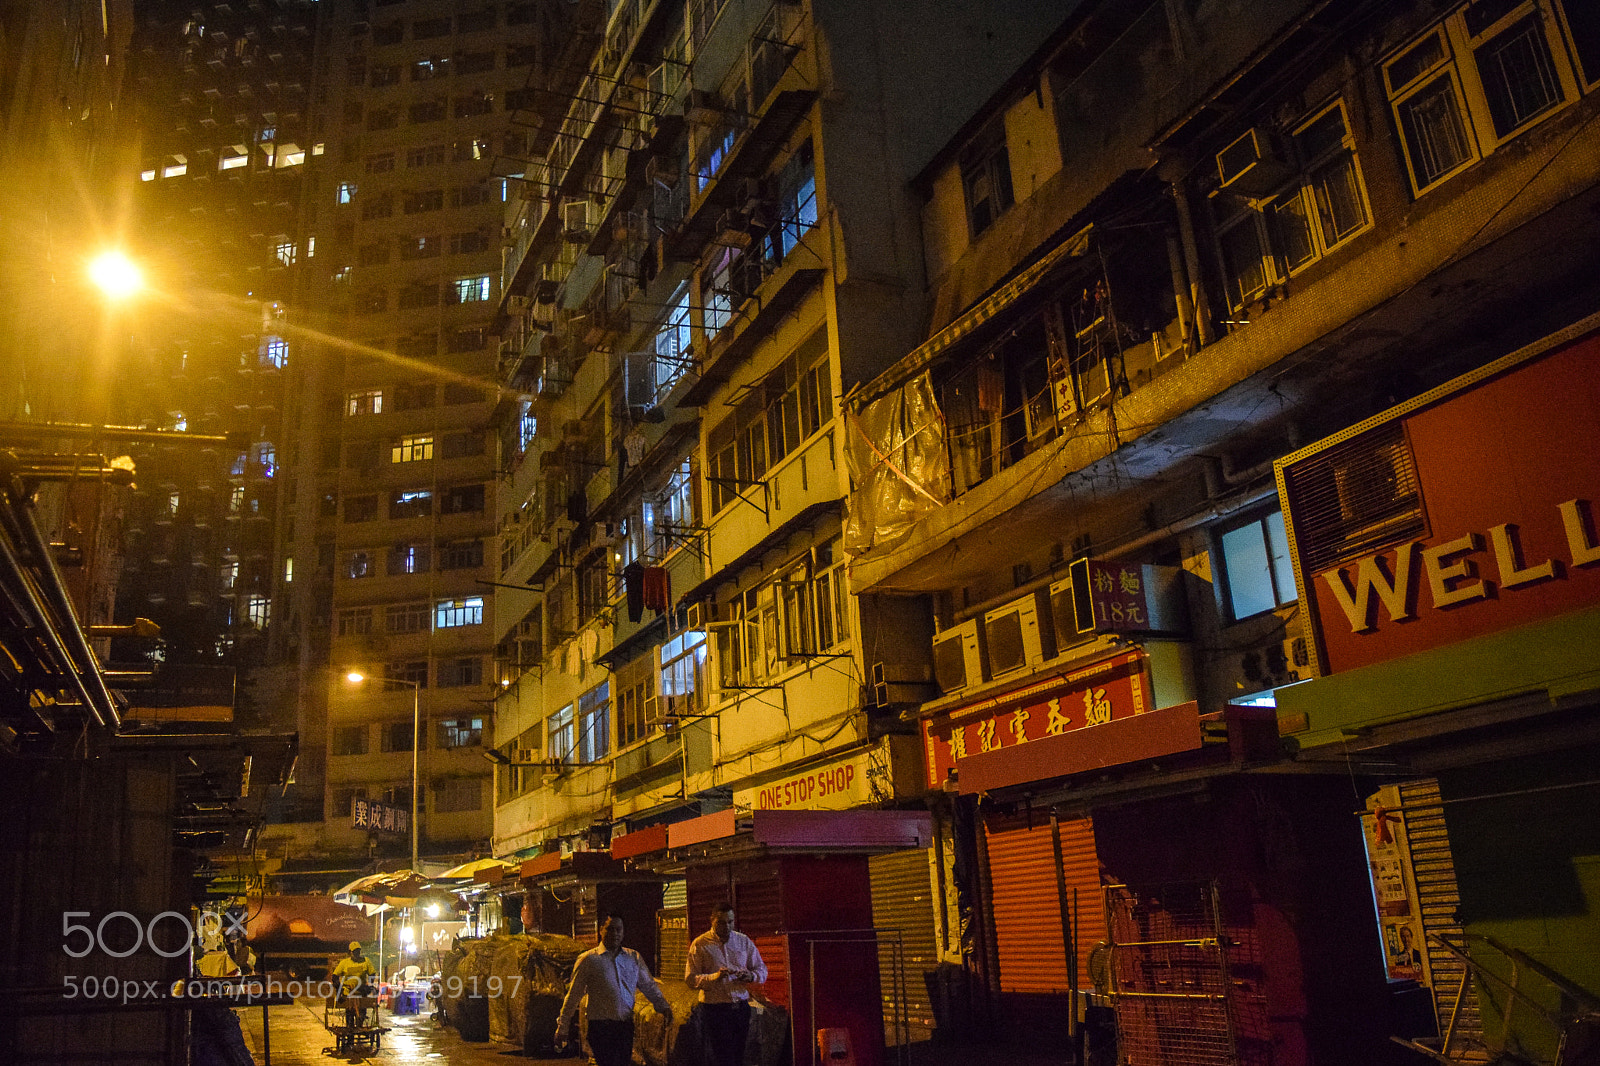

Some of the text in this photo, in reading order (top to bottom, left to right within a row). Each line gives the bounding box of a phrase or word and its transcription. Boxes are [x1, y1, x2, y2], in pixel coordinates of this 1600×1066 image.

[1322, 497, 1600, 633] WELL
[1098, 601, 1145, 624] 18元
[759, 785, 782, 811] ONE
[784, 775, 815, 806] STOP
[818, 764, 854, 797] SHOP
